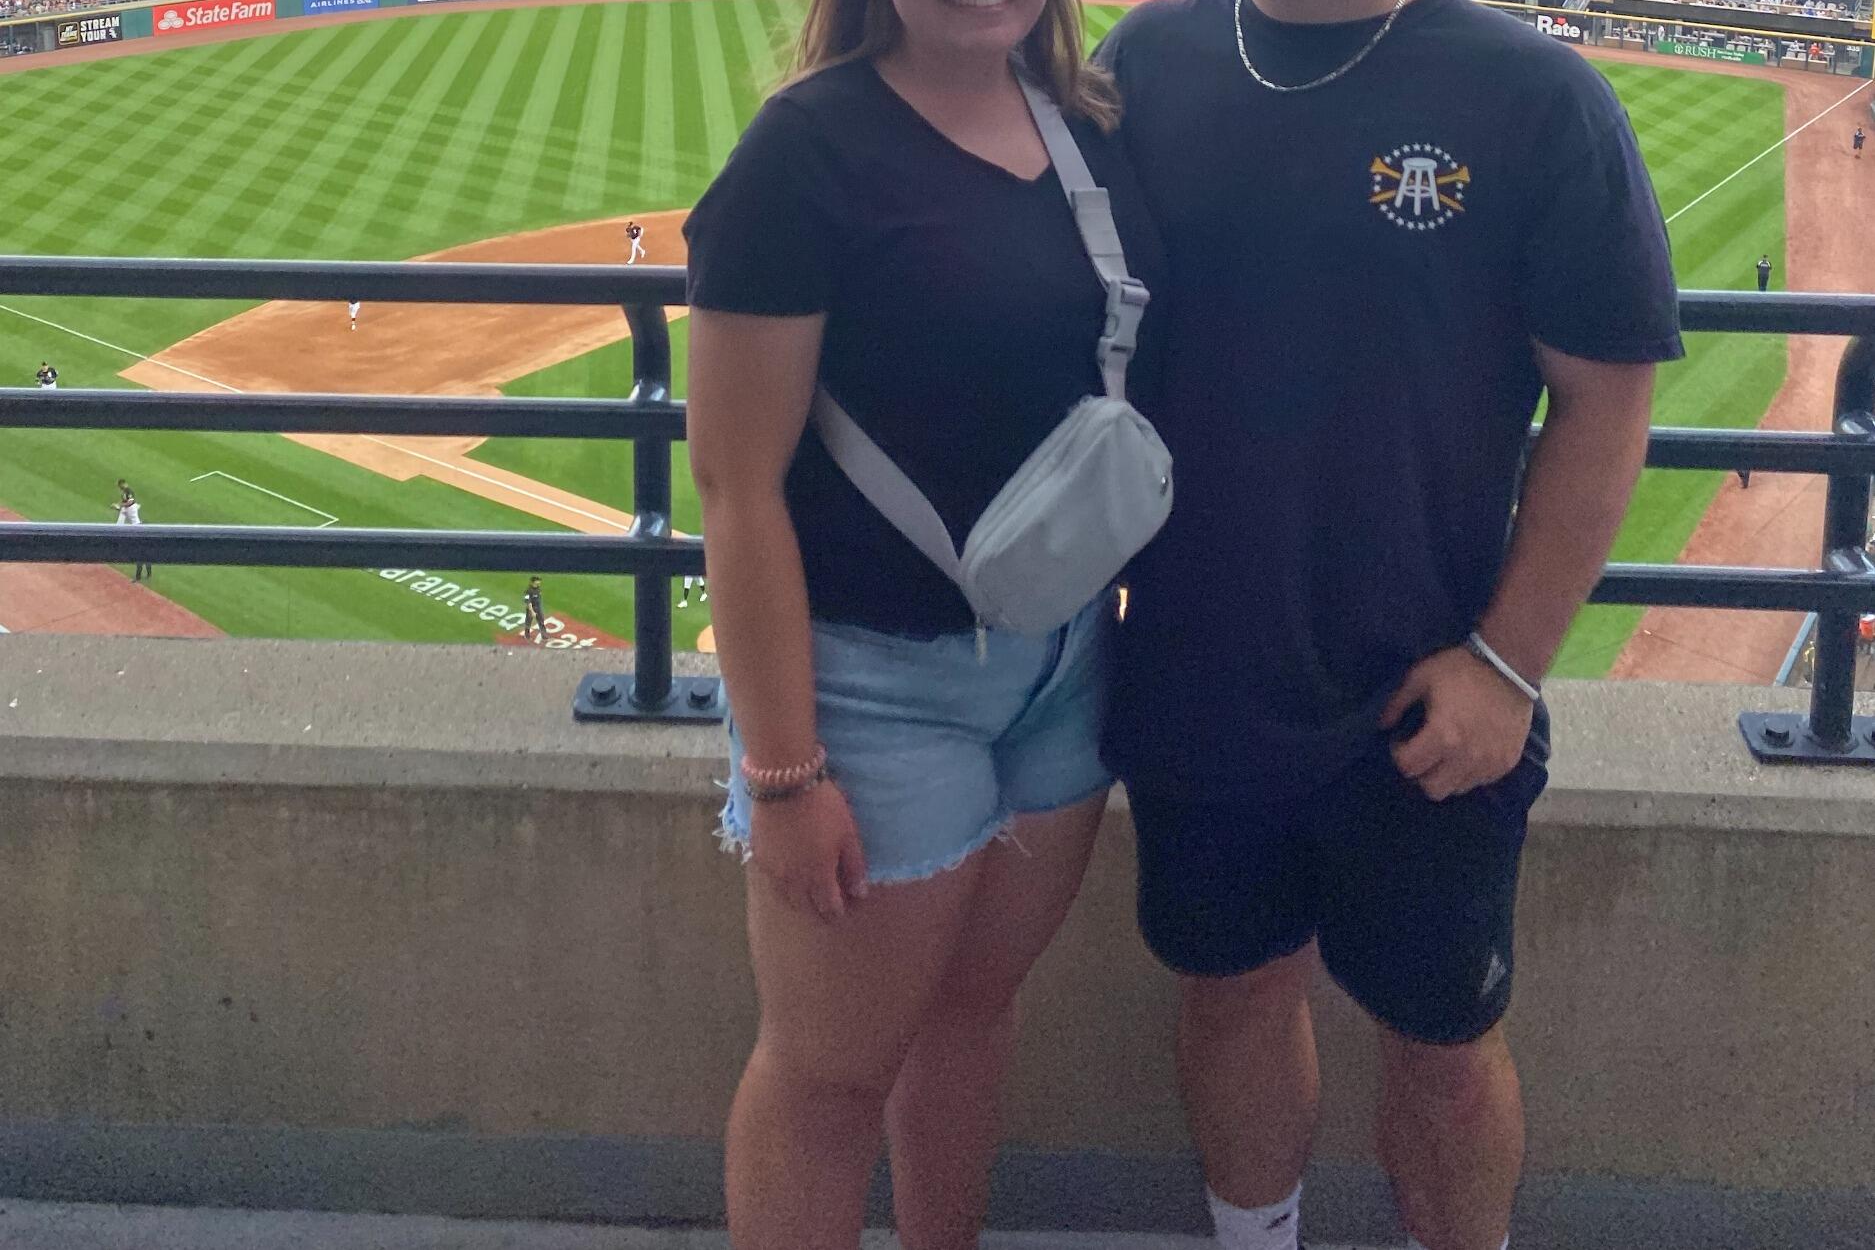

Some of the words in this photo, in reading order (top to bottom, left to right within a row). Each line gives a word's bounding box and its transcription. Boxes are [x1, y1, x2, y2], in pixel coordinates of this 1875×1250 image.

[80, 16, 120, 32] STREAM
[1537, 14, 1581, 38] Rate
[80, 29, 107, 43] YOUR
[1685, 45, 1717, 59] RUSH
[367, 568, 527, 631] aranteed
[519, 615, 605, 650] Rat
